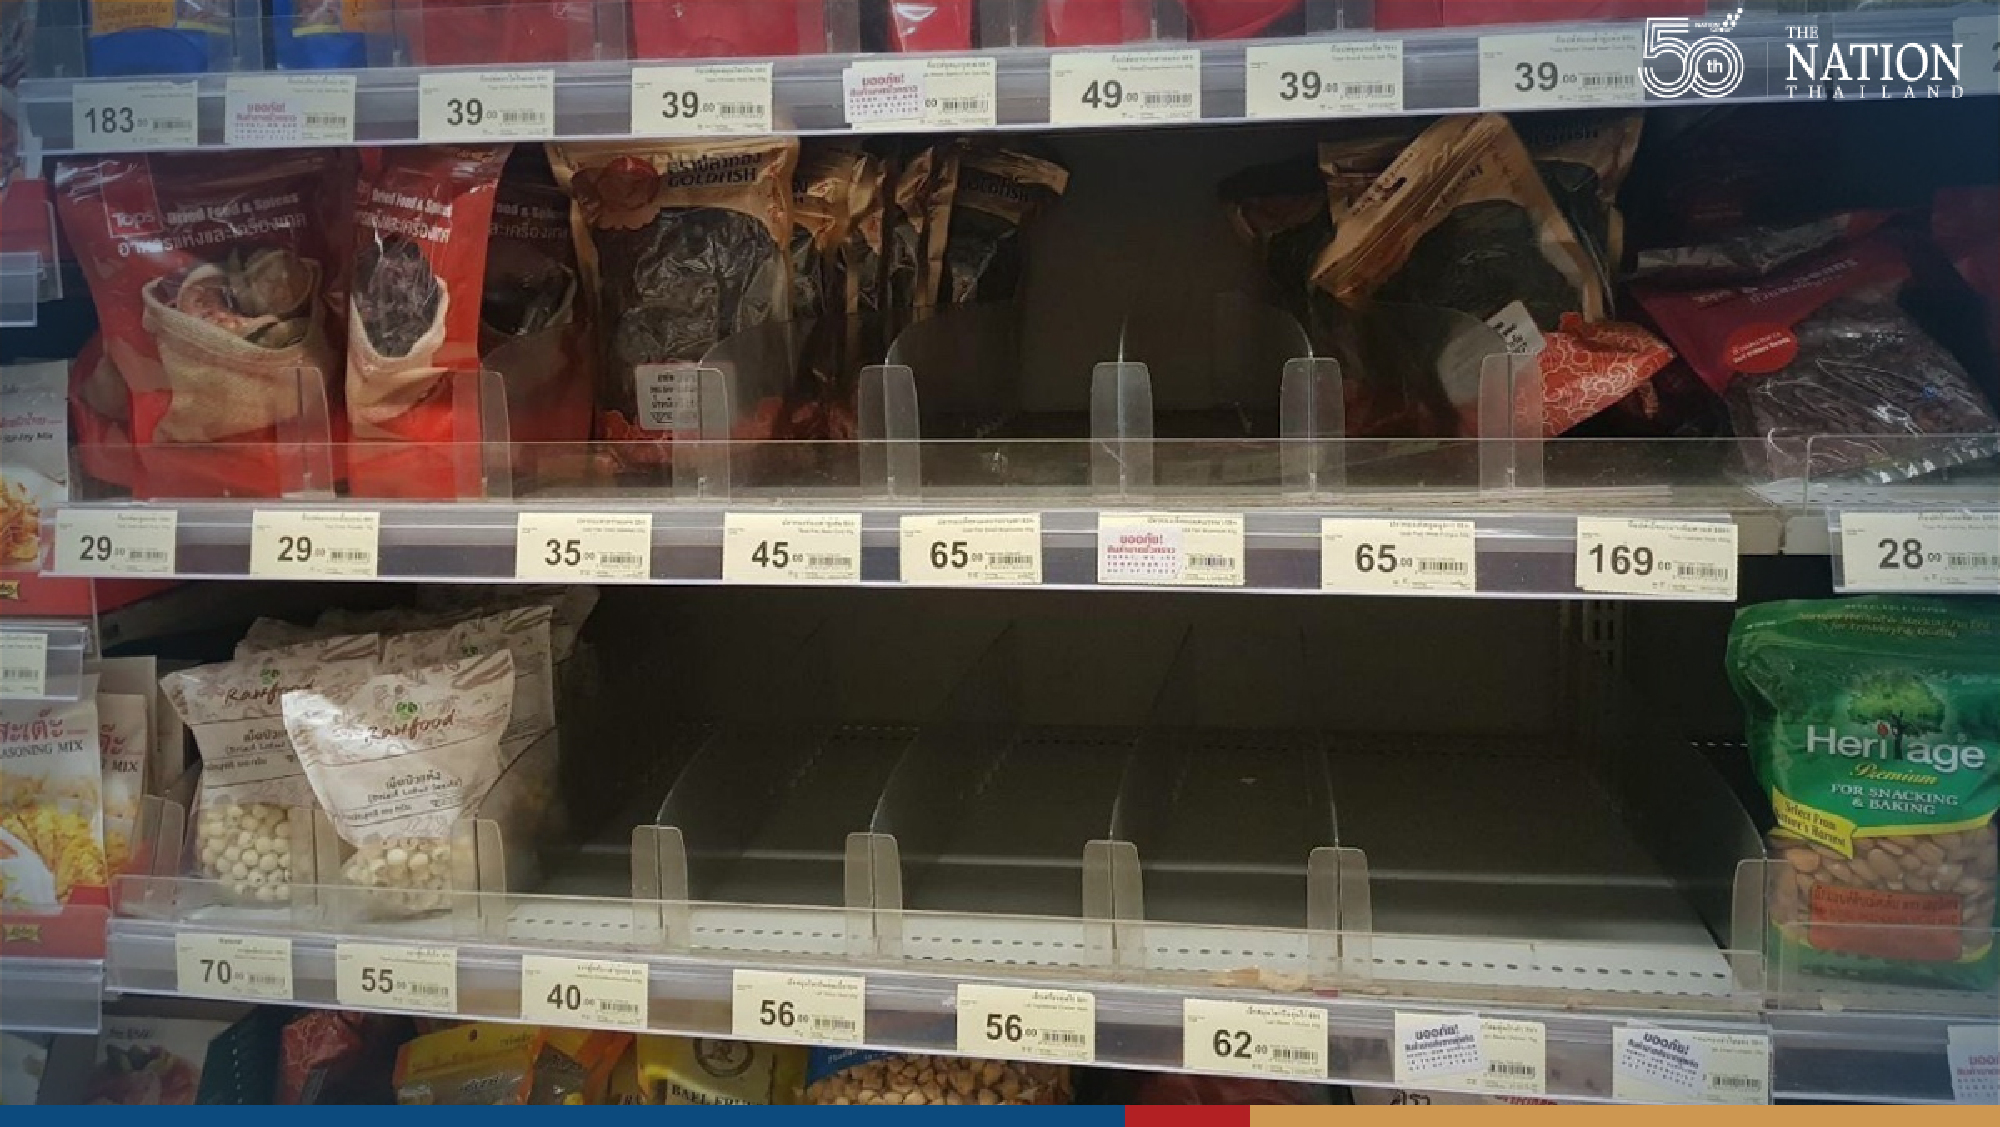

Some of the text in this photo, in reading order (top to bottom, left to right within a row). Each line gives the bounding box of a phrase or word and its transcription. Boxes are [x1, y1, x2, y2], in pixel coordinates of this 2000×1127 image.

[1280, 71, 1321, 101] 39
[1515, 62, 1558, 92] 39
[662, 91, 698, 119] 39
[1082, 80, 1121, 109] 49
[85, 107, 133, 133] 183
[447, 98, 484, 126] 39
[667, 167, 756, 188] GOLDFISH
[80, 535, 113, 562] 29
[277, 536, 312, 562] 29
[545, 538, 581, 566] 35
[751, 540, 789, 569] 45
[930, 540, 968, 569] 65
[1354, 543, 1397, 573] 65
[1588, 543, 1653, 576] 169
[1878, 538, 1924, 570] 28
[58, 739, 84, 755] MIX
[112, 760, 138, 773] MIX
[1831, 783, 1959, 806] FOR SNACKING
[1869, 799, 1936, 815] BAKING
[200, 959, 231, 984] 70
[362, 967, 393, 994] 55
[547, 984, 581, 1011] 40
[760, 999, 795, 1028] 56
[987, 1014, 1023, 1043] 56
[1213, 1029, 1252, 1060] 62
